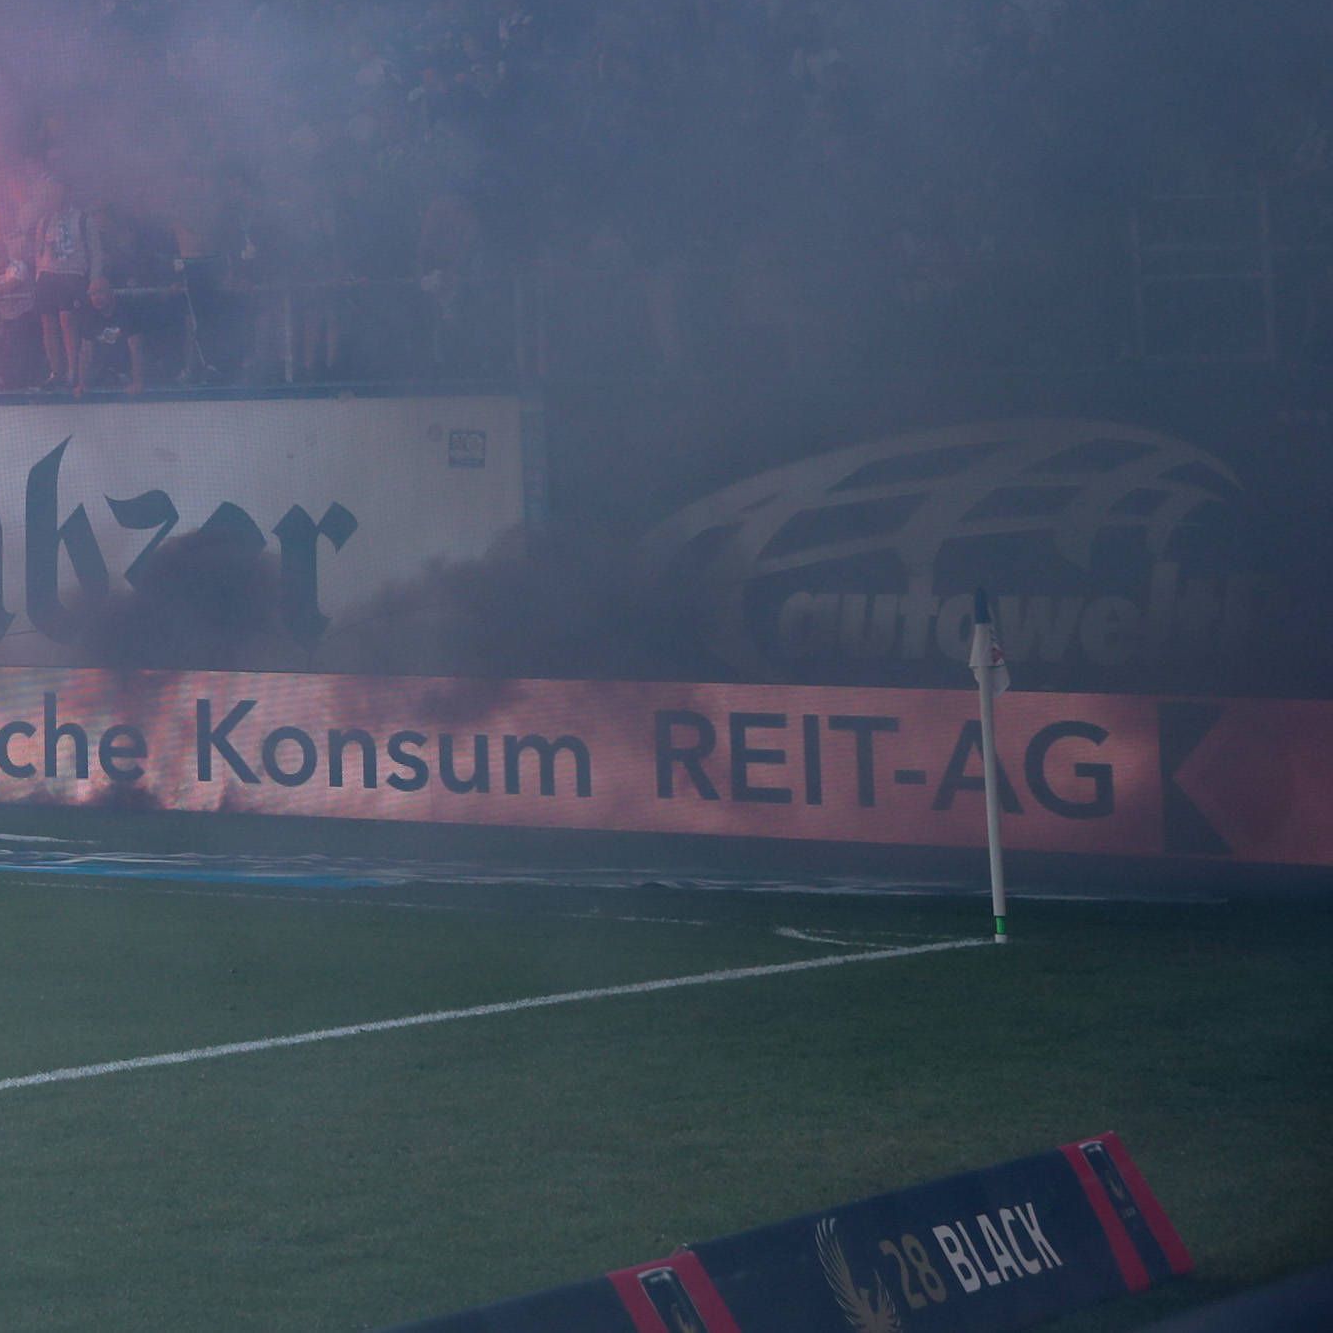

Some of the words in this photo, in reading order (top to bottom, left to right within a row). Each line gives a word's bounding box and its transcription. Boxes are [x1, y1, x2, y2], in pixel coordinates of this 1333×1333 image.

[196, 699, 592, 798] Konsum
[654, 709, 1116, 818] REIT-AG
[879, 1234, 947, 1310] 28
[933, 1201, 1064, 1294] BLACK
